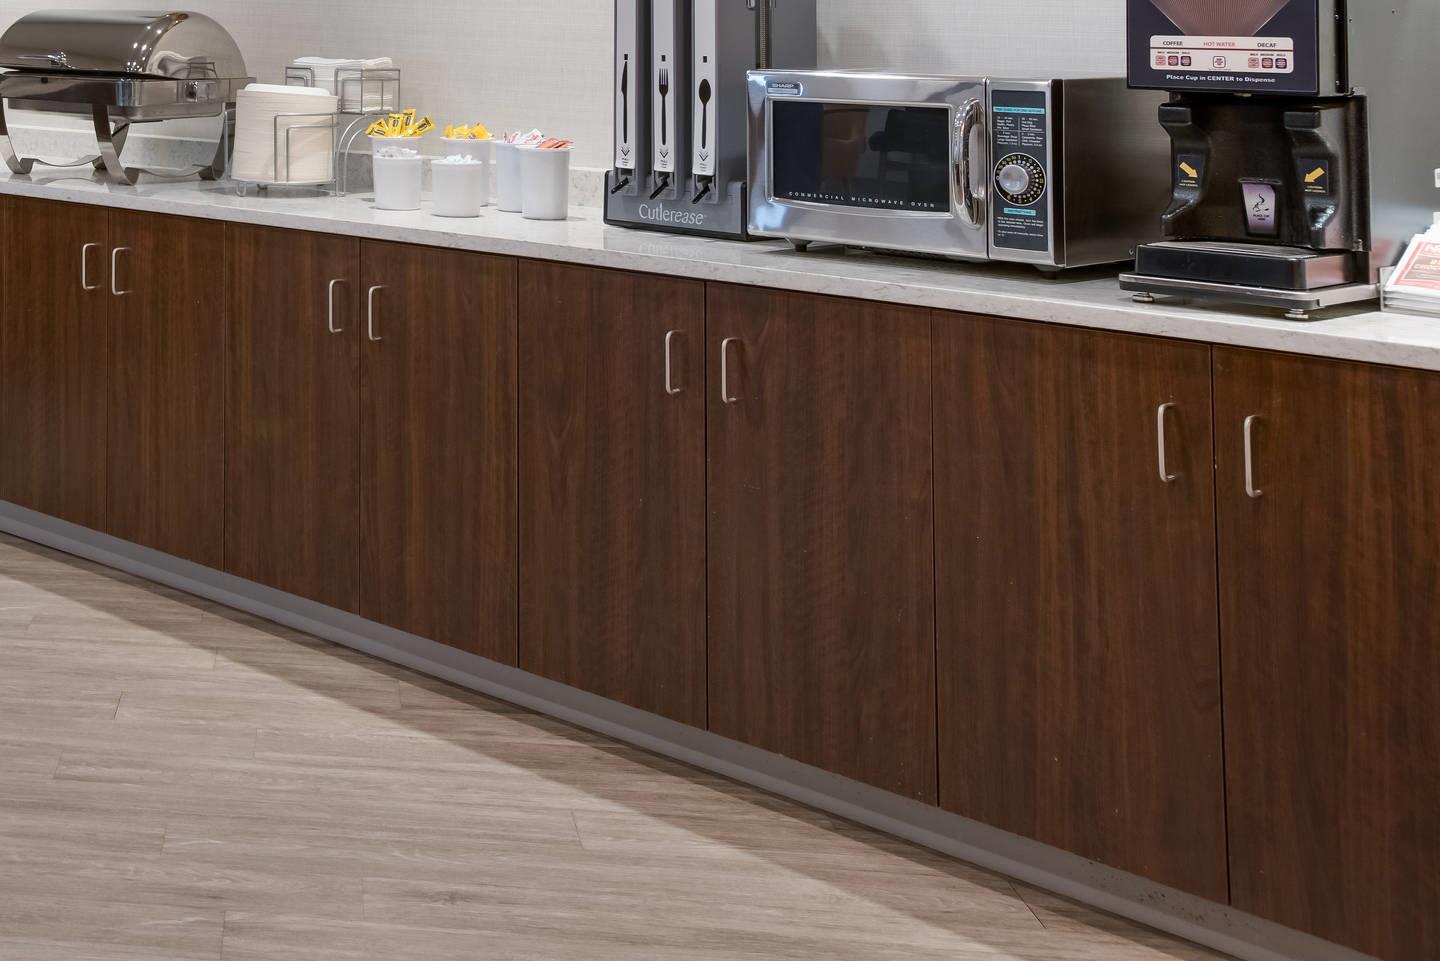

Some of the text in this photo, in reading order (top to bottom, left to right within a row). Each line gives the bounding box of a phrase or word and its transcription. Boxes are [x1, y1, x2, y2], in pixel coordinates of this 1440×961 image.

[788, 191, 845, 200] COMMERCIAL
[851, 197, 904, 205] MICROWAVE
[638, 202, 704, 225] Cutlerease
